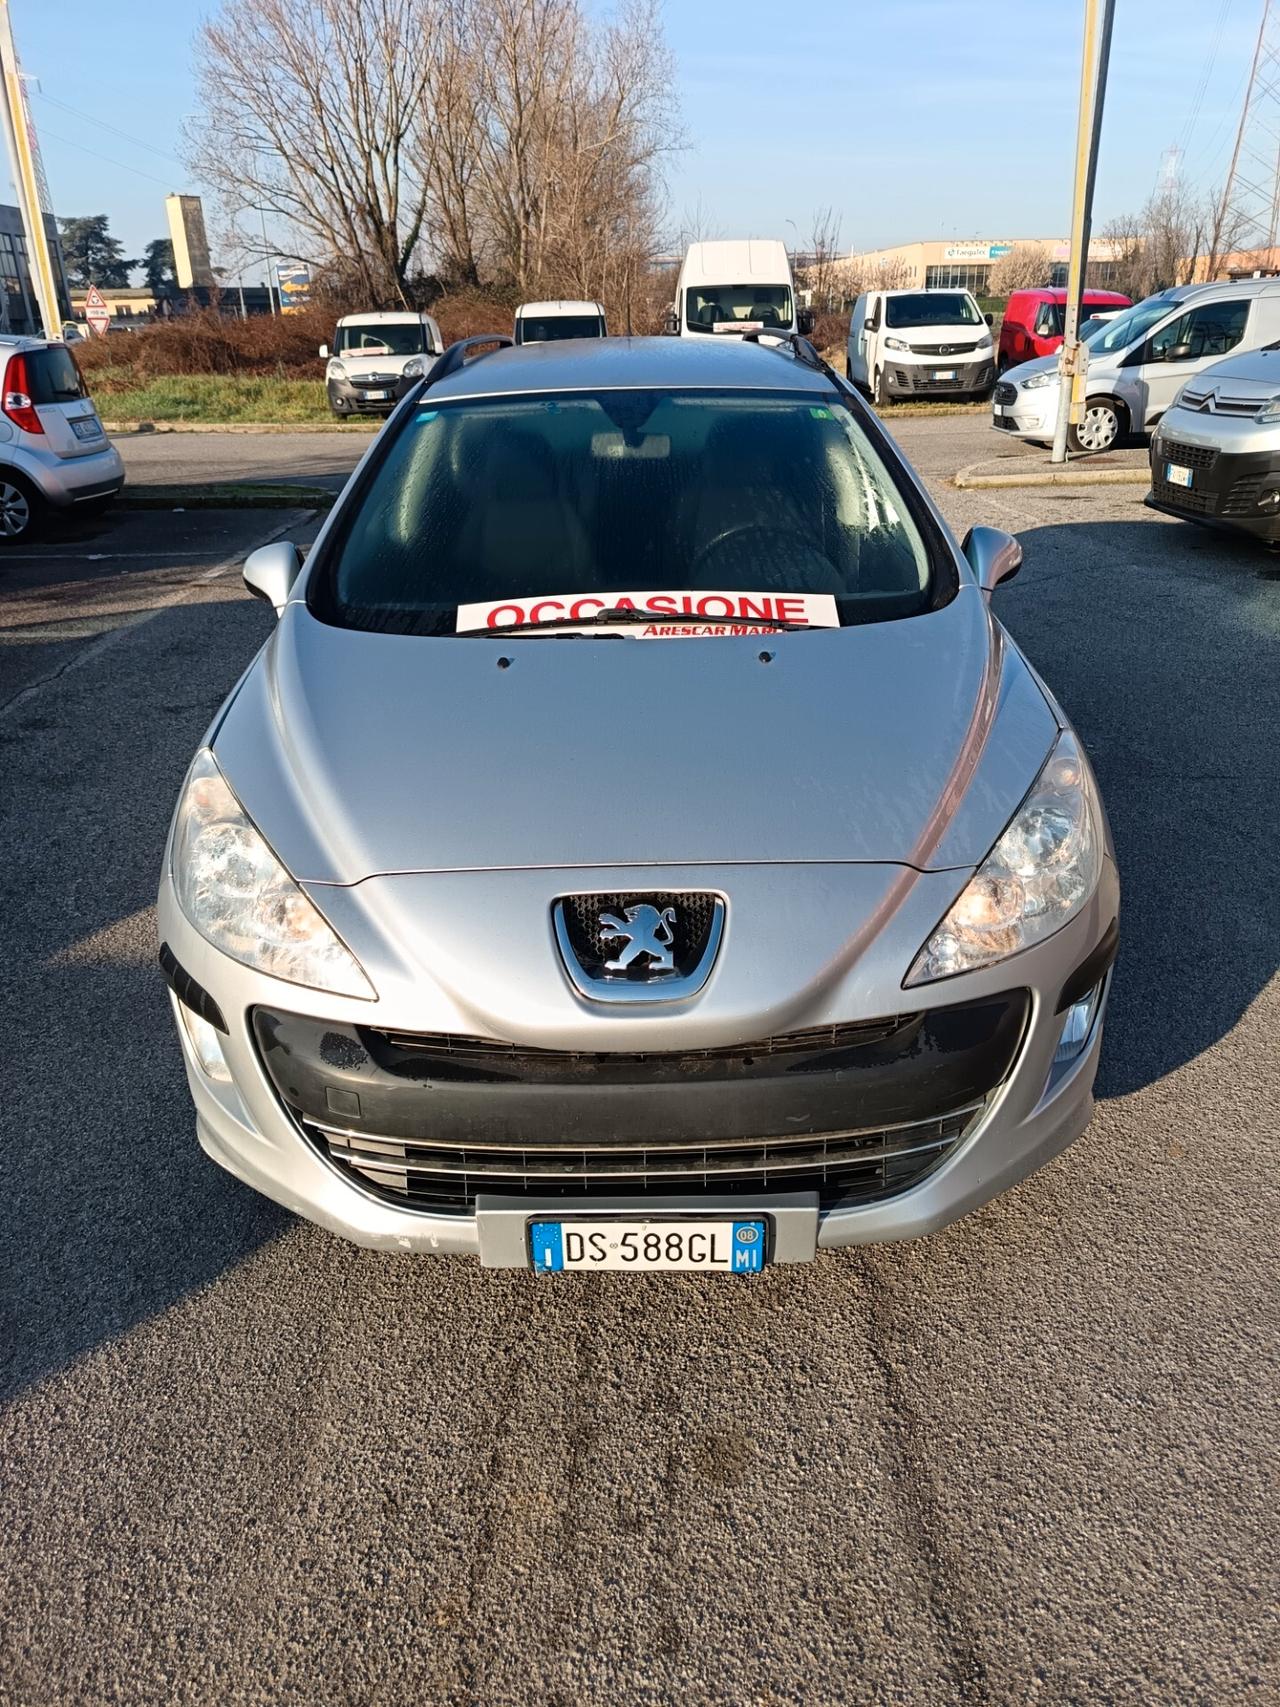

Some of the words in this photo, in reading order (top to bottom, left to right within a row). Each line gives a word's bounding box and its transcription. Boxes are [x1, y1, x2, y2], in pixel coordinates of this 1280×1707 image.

[642, 624, 726, 636] ARESCAR
[740, 1230, 754, 1241] 08
[735, 1249, 757, 1268] MI
